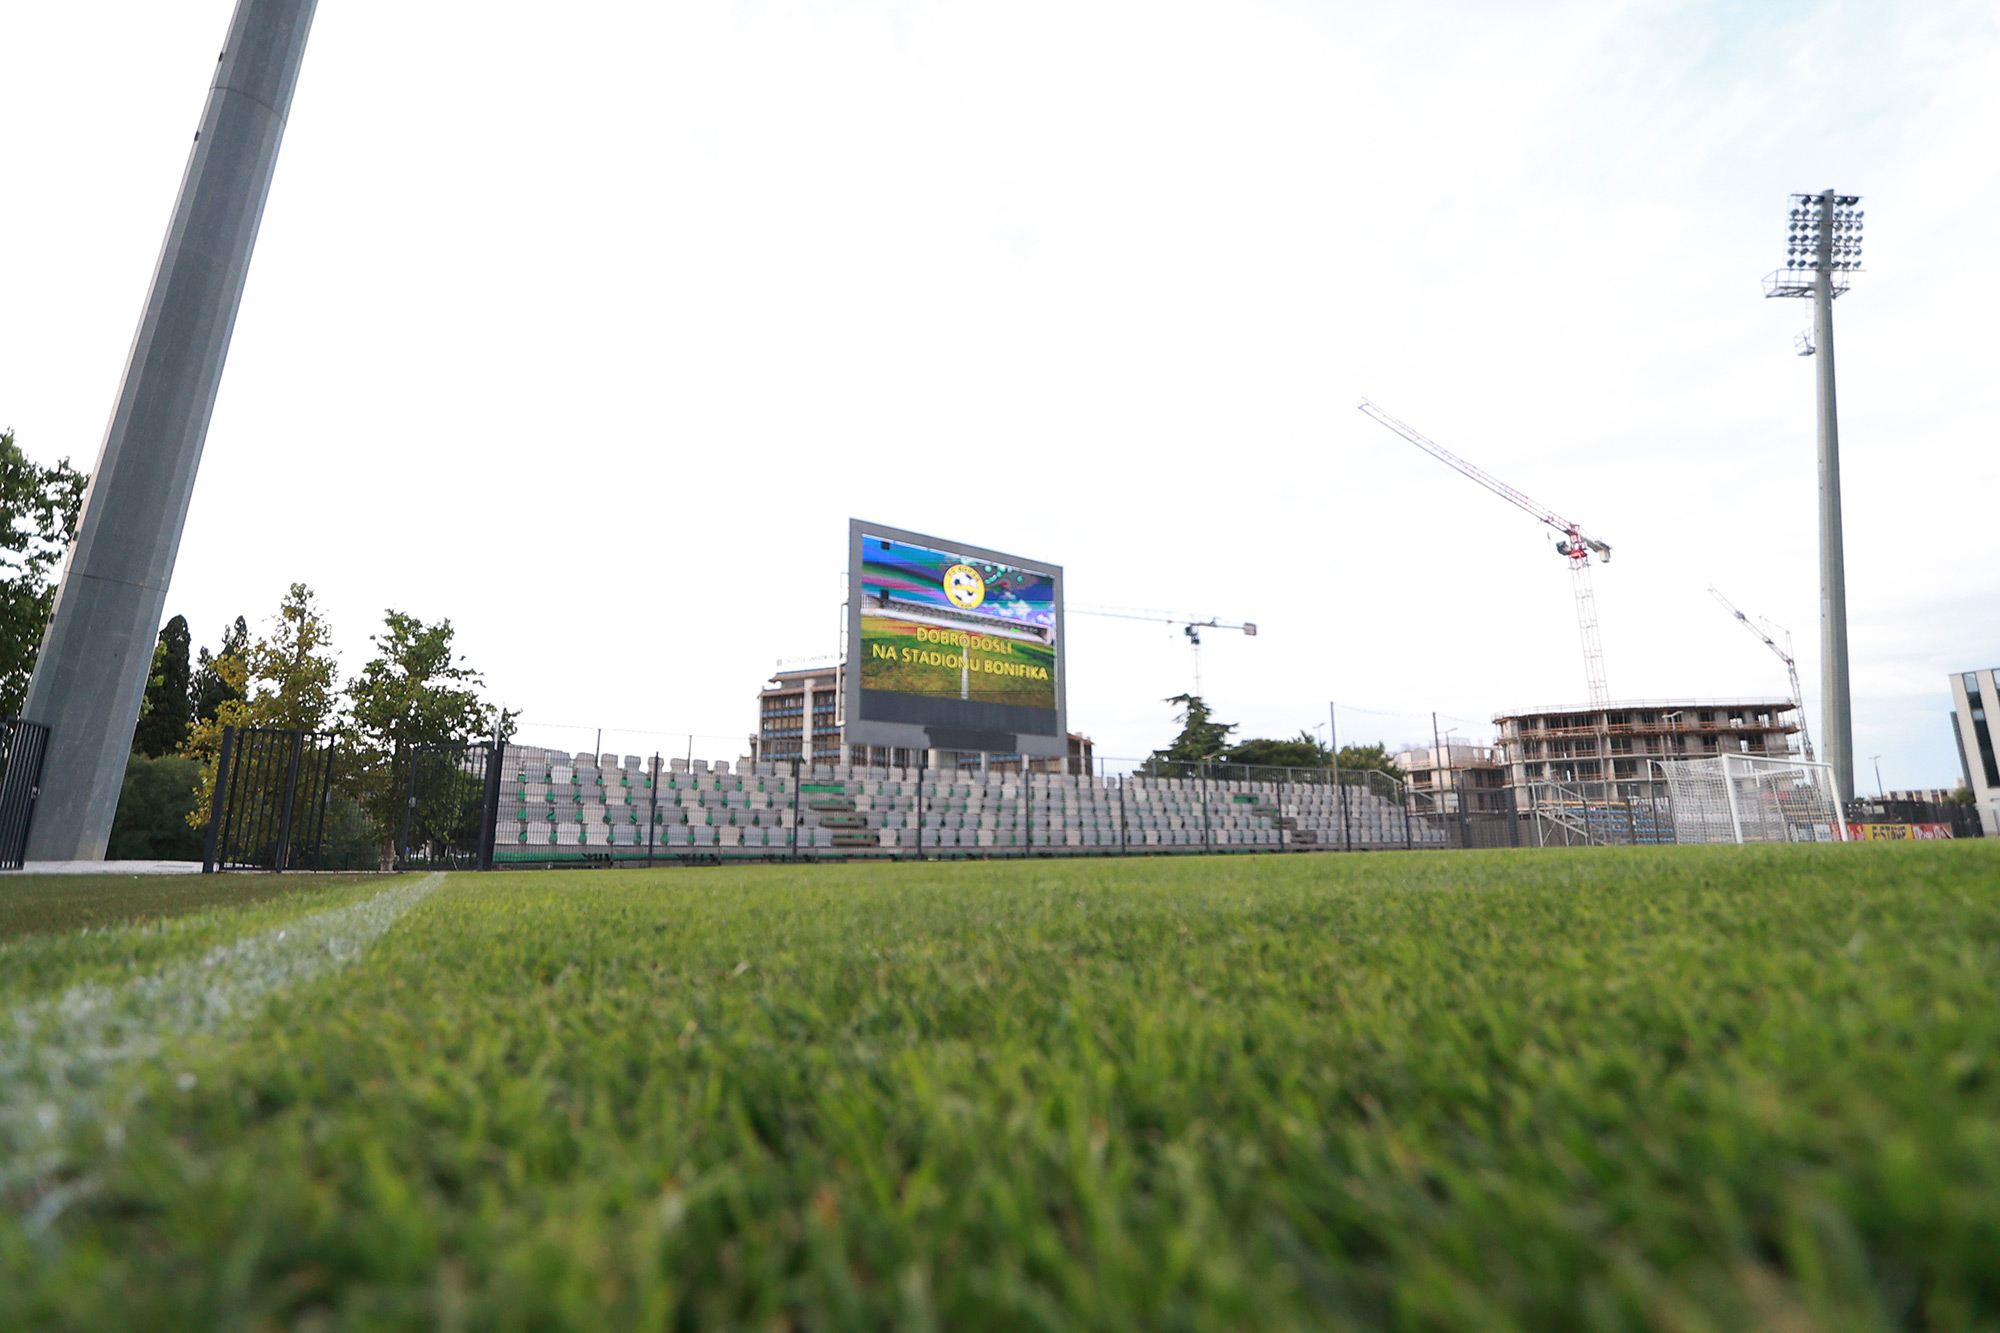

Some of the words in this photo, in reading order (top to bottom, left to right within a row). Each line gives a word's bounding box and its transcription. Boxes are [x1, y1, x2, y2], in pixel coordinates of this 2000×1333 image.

[872, 643, 897, 661] NA
[902, 647, 980, 672] STADIONU
[984, 660, 1049, 681] BONIFIKA
